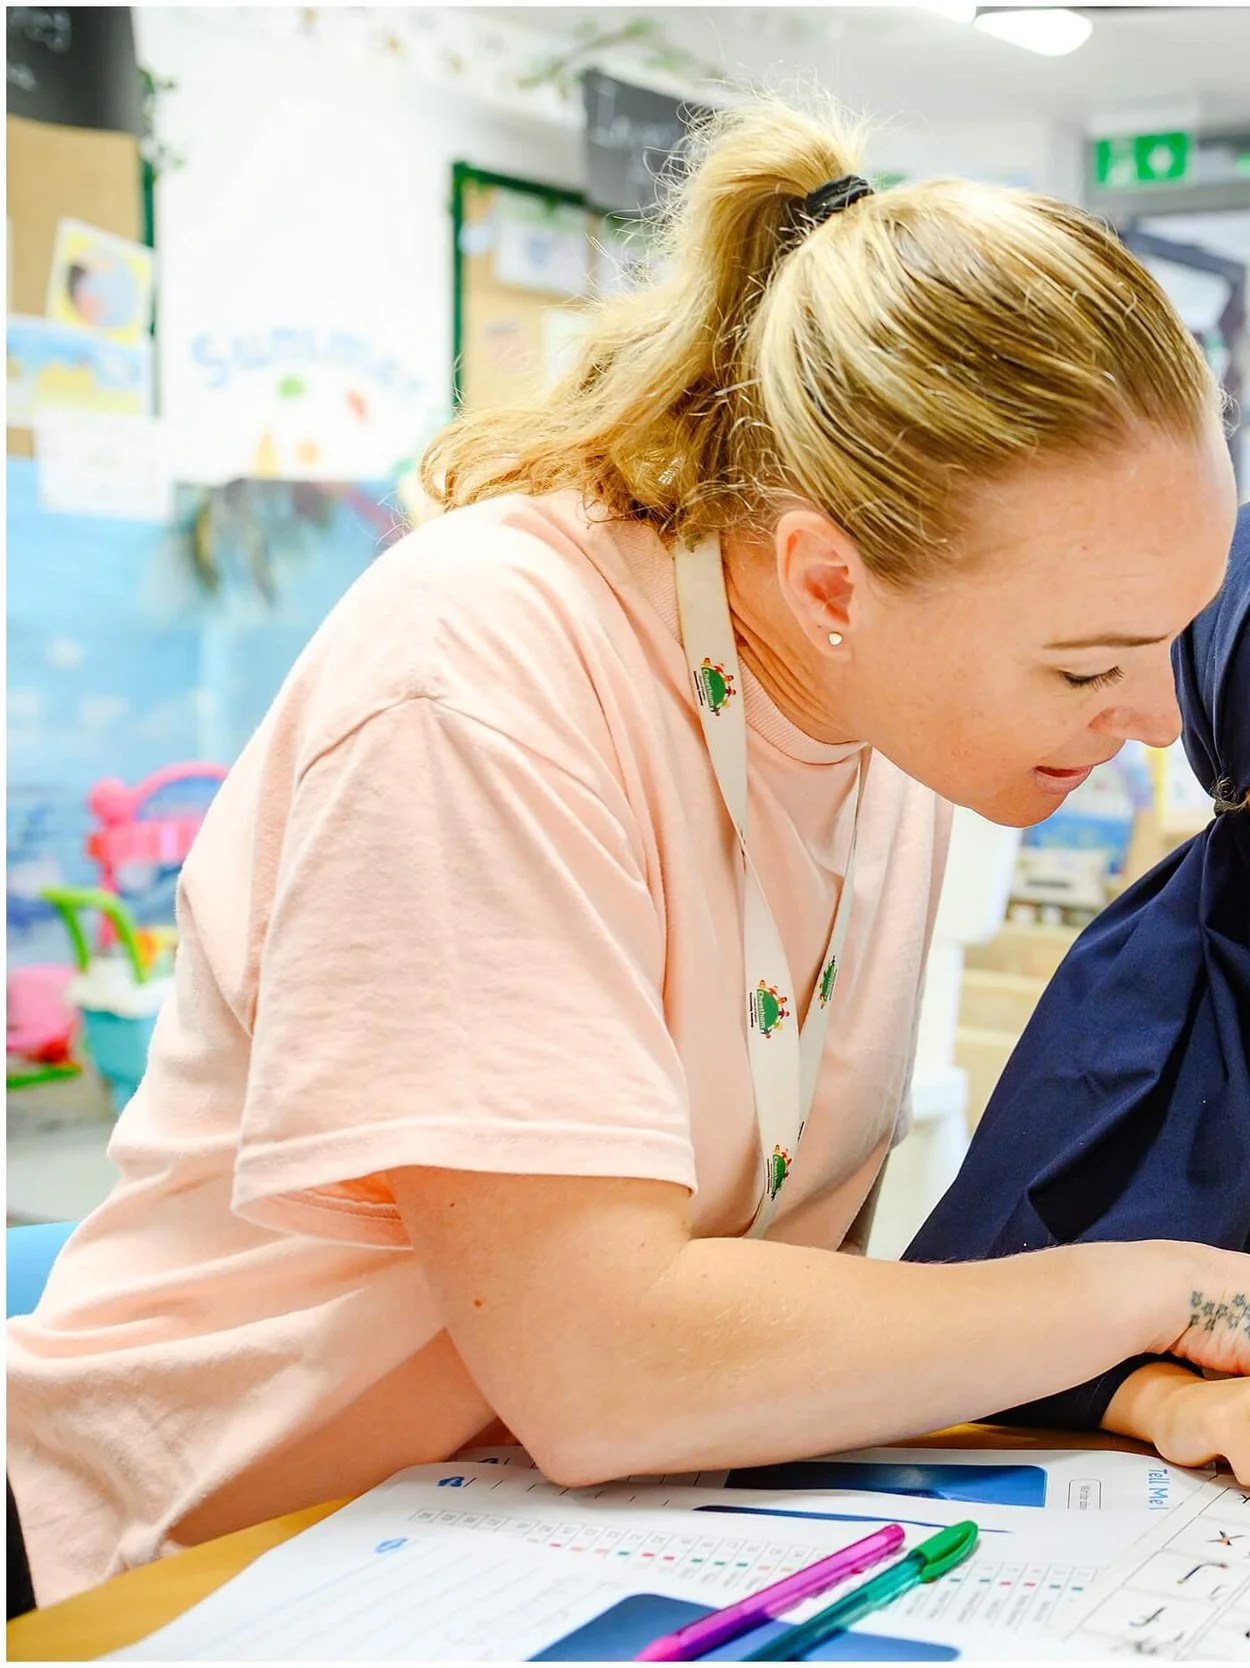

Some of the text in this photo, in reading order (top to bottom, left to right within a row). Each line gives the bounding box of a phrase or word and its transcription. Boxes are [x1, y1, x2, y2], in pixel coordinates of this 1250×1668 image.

[1148, 1468, 1170, 1484] Tell
[1148, 1487, 1169, 1505] Me
[1206, 1529, 1246, 1546] x
